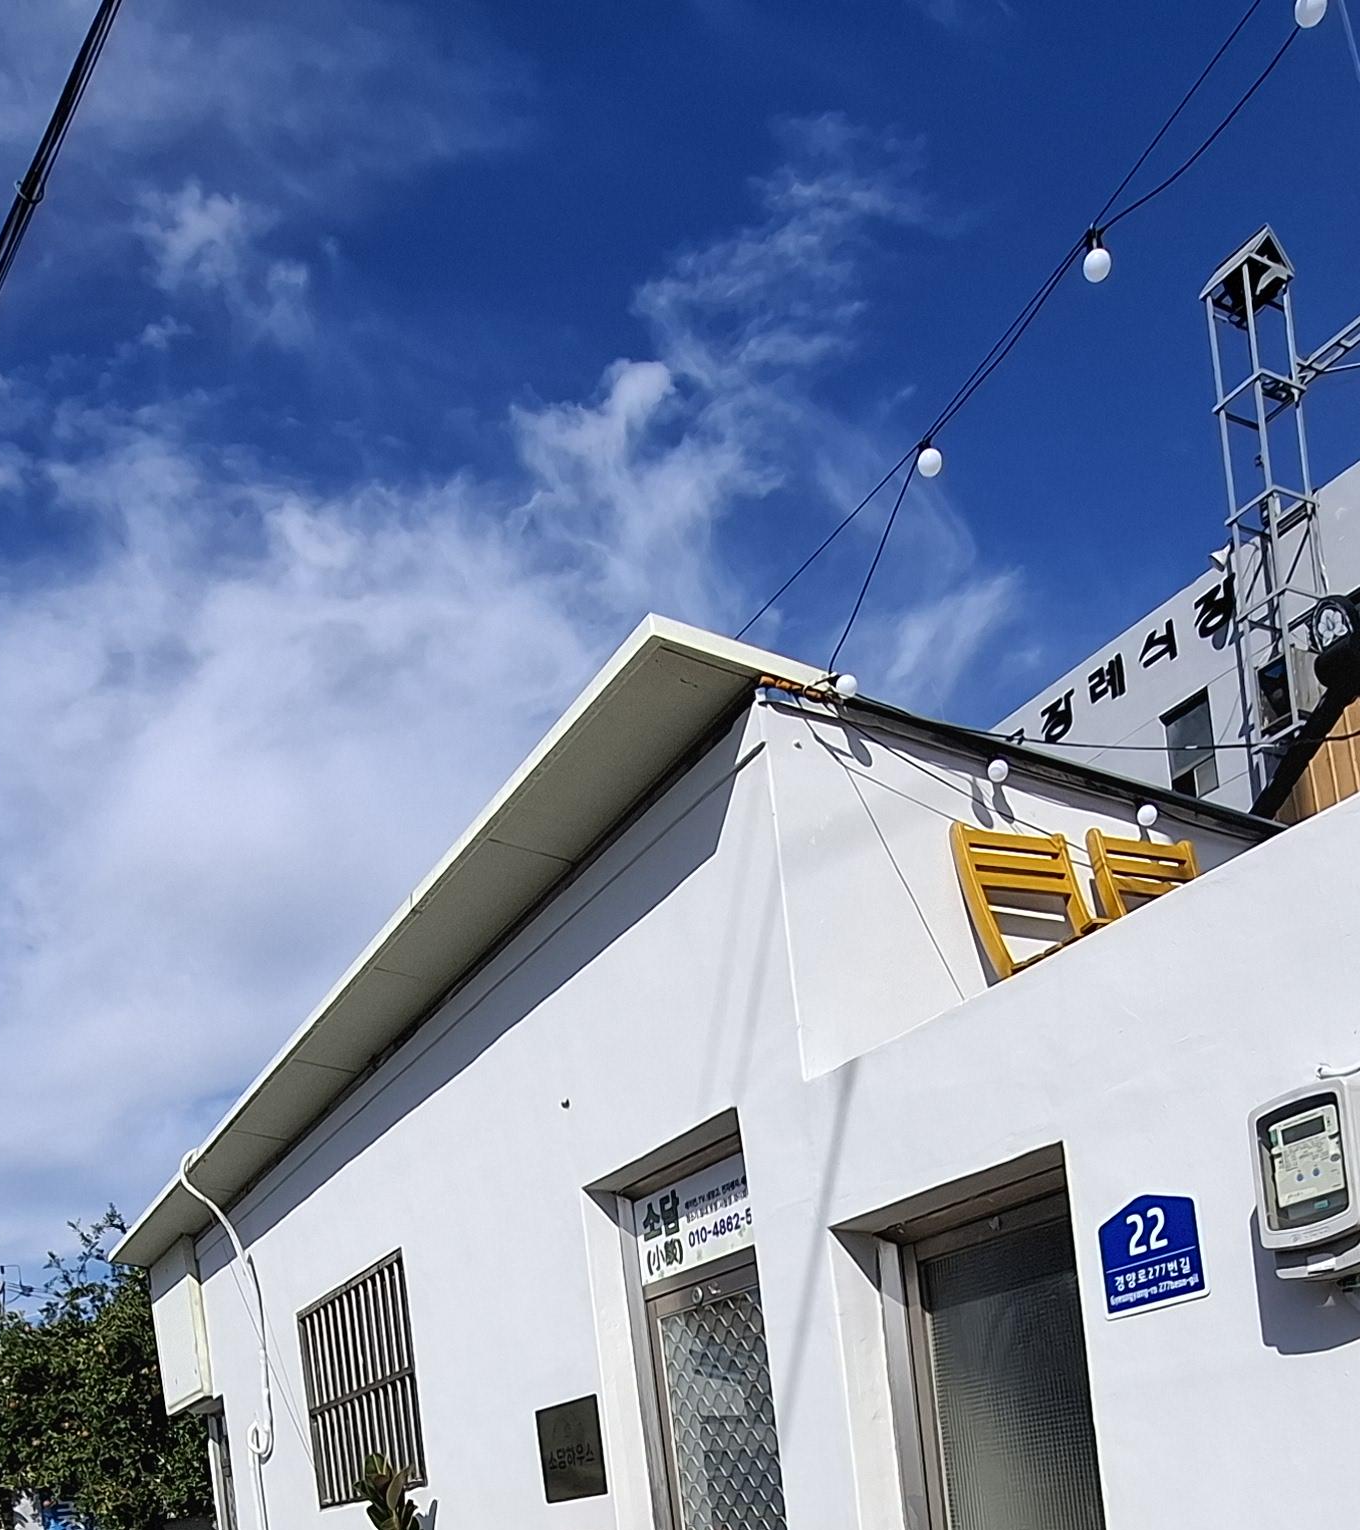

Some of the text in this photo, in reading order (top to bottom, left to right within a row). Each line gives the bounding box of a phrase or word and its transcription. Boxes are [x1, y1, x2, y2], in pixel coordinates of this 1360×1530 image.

[643, 1189, 680, 1242] 소담
[1126, 1207, 1168, 1256] 22
[1114, 1256, 1191, 1291] 경양로277번길
[549, 1442, 596, 1471] 소담하우스
